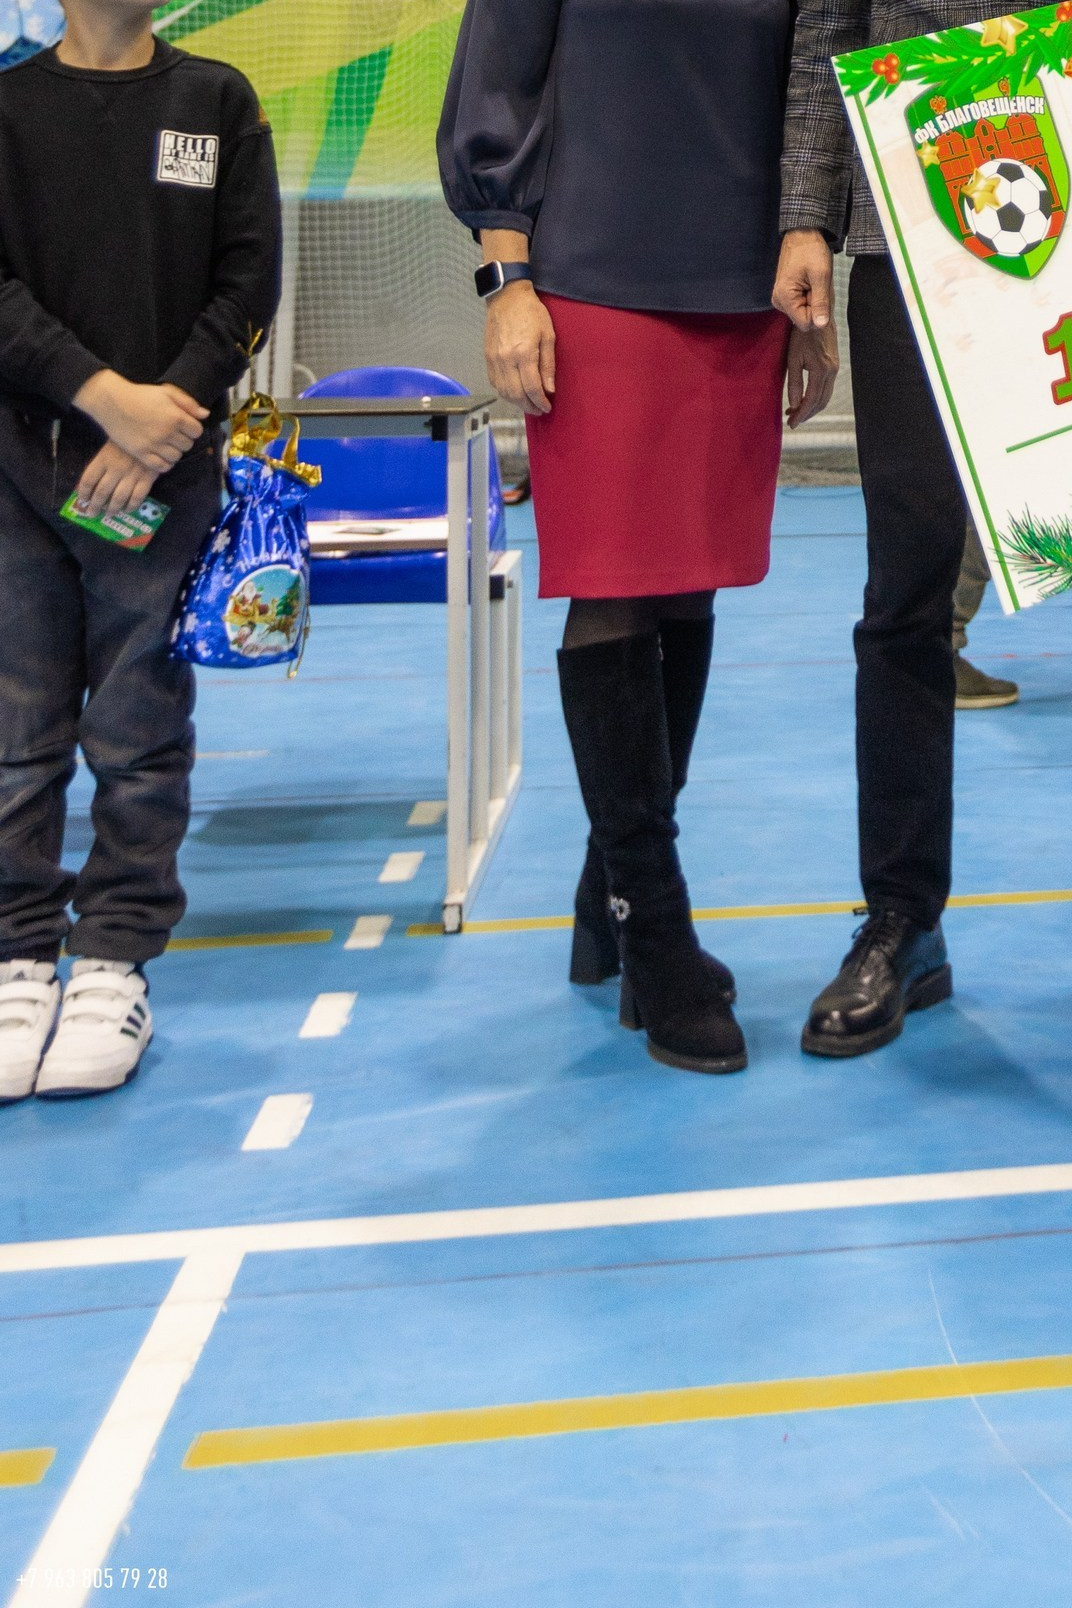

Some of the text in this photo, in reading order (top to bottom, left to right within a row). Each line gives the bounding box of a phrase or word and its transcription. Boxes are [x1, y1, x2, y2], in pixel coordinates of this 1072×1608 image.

[914, 95, 1045, 144] ФК БЛАГОВЕЩЕНСК
[164, 134, 216, 154] HELLO
